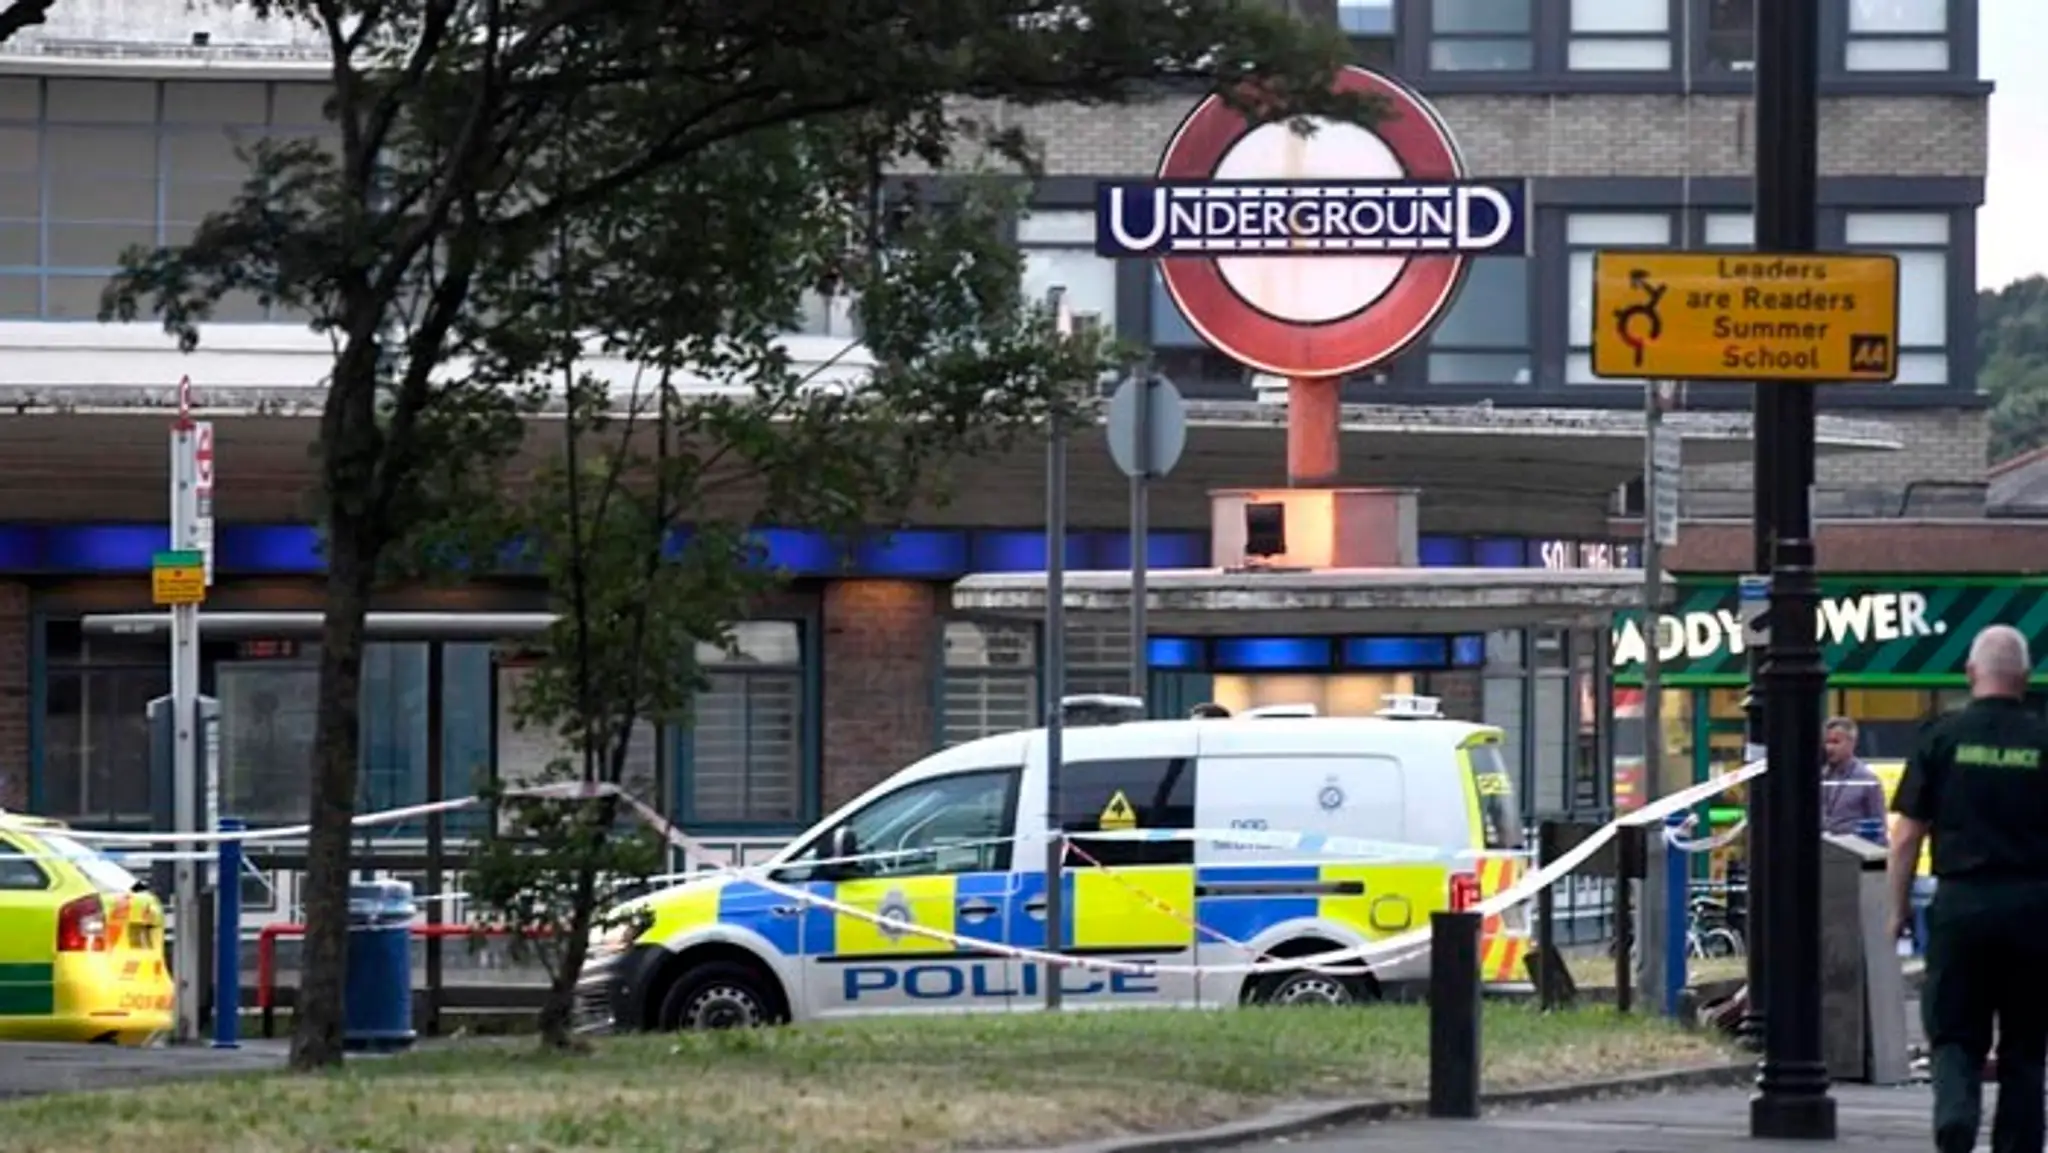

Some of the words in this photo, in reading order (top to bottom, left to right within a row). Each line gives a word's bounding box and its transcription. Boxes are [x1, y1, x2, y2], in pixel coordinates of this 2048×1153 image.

[1110, 187, 1512, 250] UNDERGROUND
[1717, 258, 1827, 280] Leaders
[1686, 289, 1731, 309] are
[1742, 286, 1856, 311] Readers
[1713, 316, 1830, 340] Summer
[1721, 345, 1820, 370] School
[1612, 608, 1746, 666] ADDY
[1815, 591, 1947, 644] WER.
